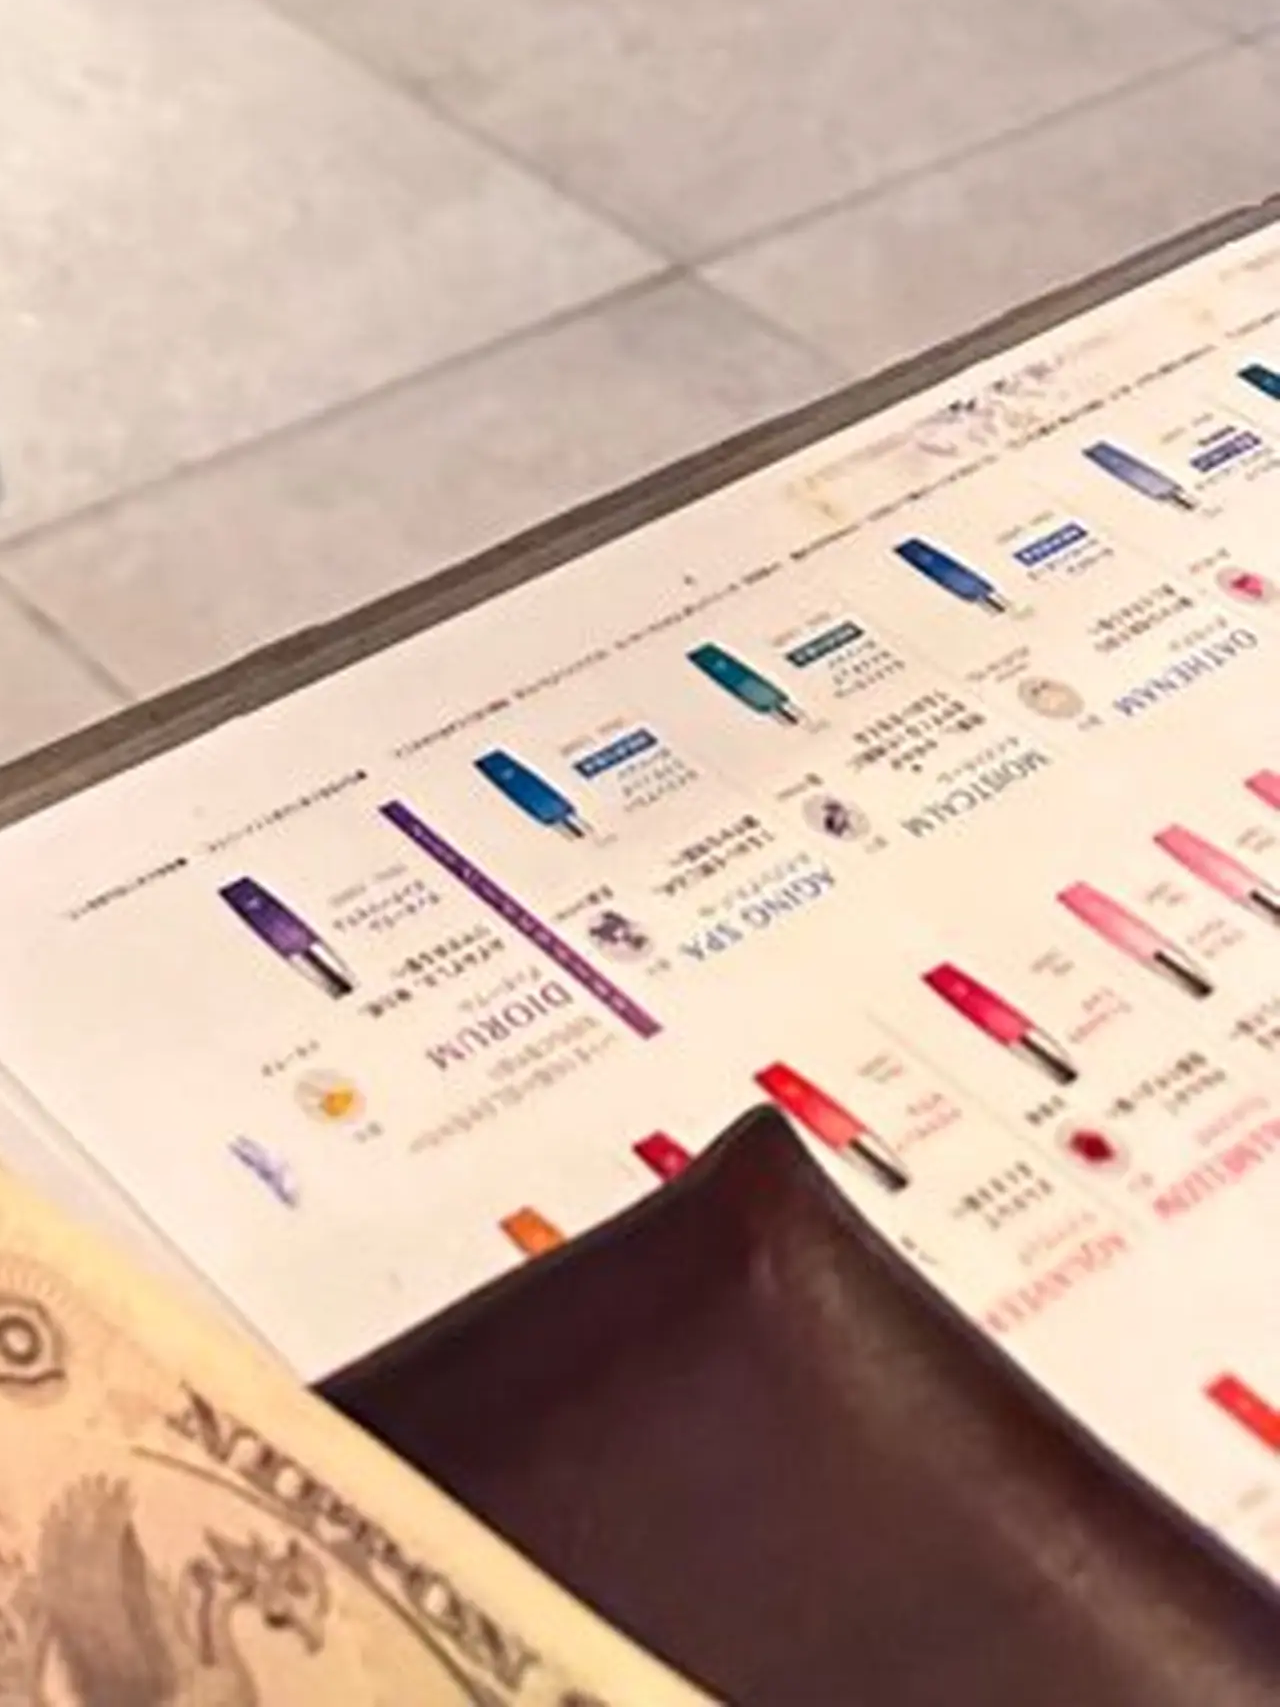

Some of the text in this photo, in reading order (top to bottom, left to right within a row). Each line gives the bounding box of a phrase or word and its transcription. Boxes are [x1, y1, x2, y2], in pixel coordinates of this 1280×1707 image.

[742, 868, 836, 930] AGING
[681, 923, 743, 963] SPA
[423, 979, 574, 1069] DIORUM
[167, 1382, 541, 1691] NIPPON
